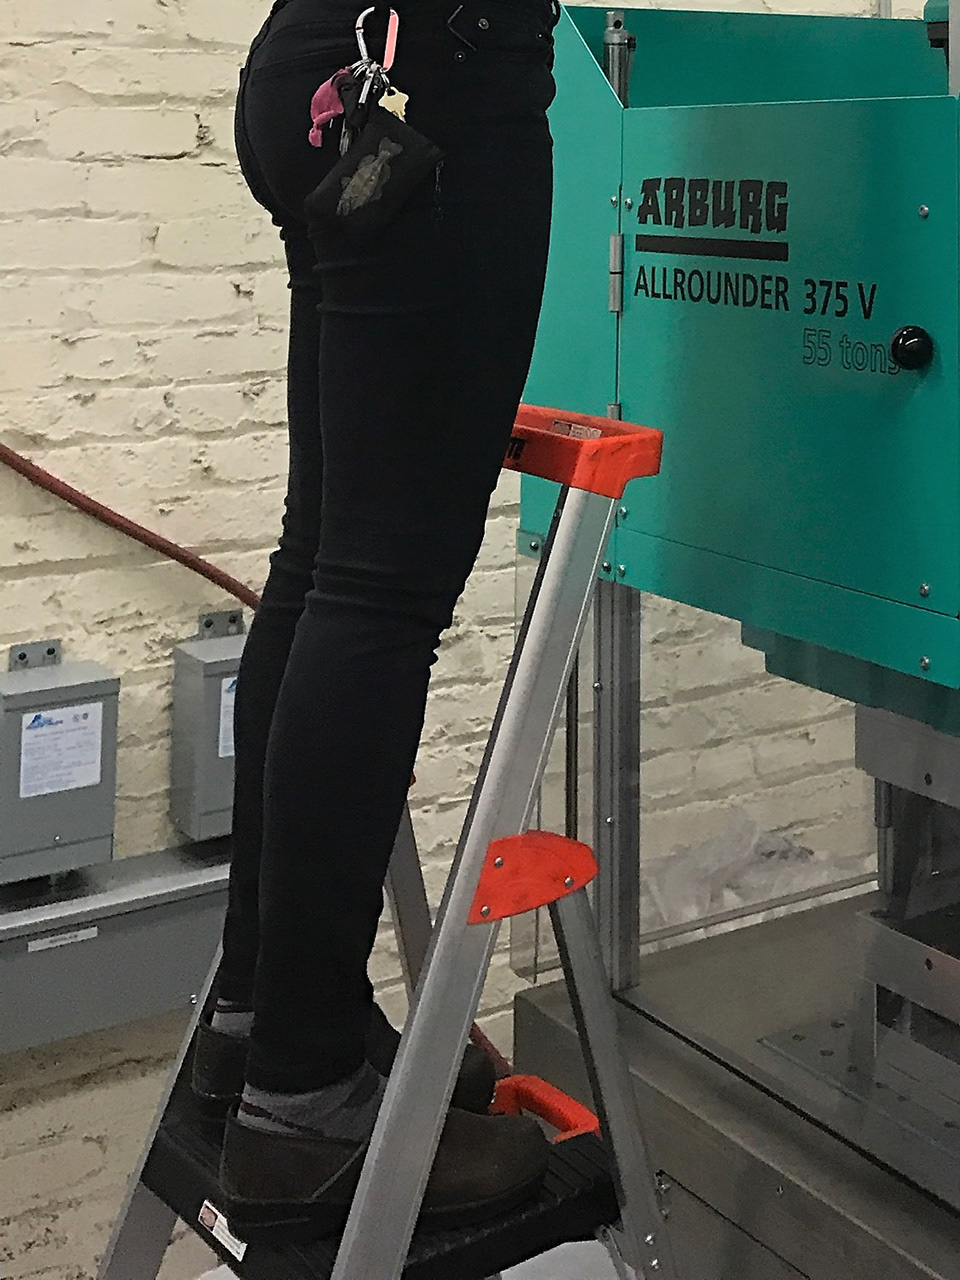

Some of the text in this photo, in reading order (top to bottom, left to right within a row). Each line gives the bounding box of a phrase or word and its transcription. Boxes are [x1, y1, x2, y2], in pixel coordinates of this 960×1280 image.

[637, 177, 789, 233] ARBURG
[633, 265, 878, 320] ALLROUNDER 375 V
[802, 327, 832, 367] 55
